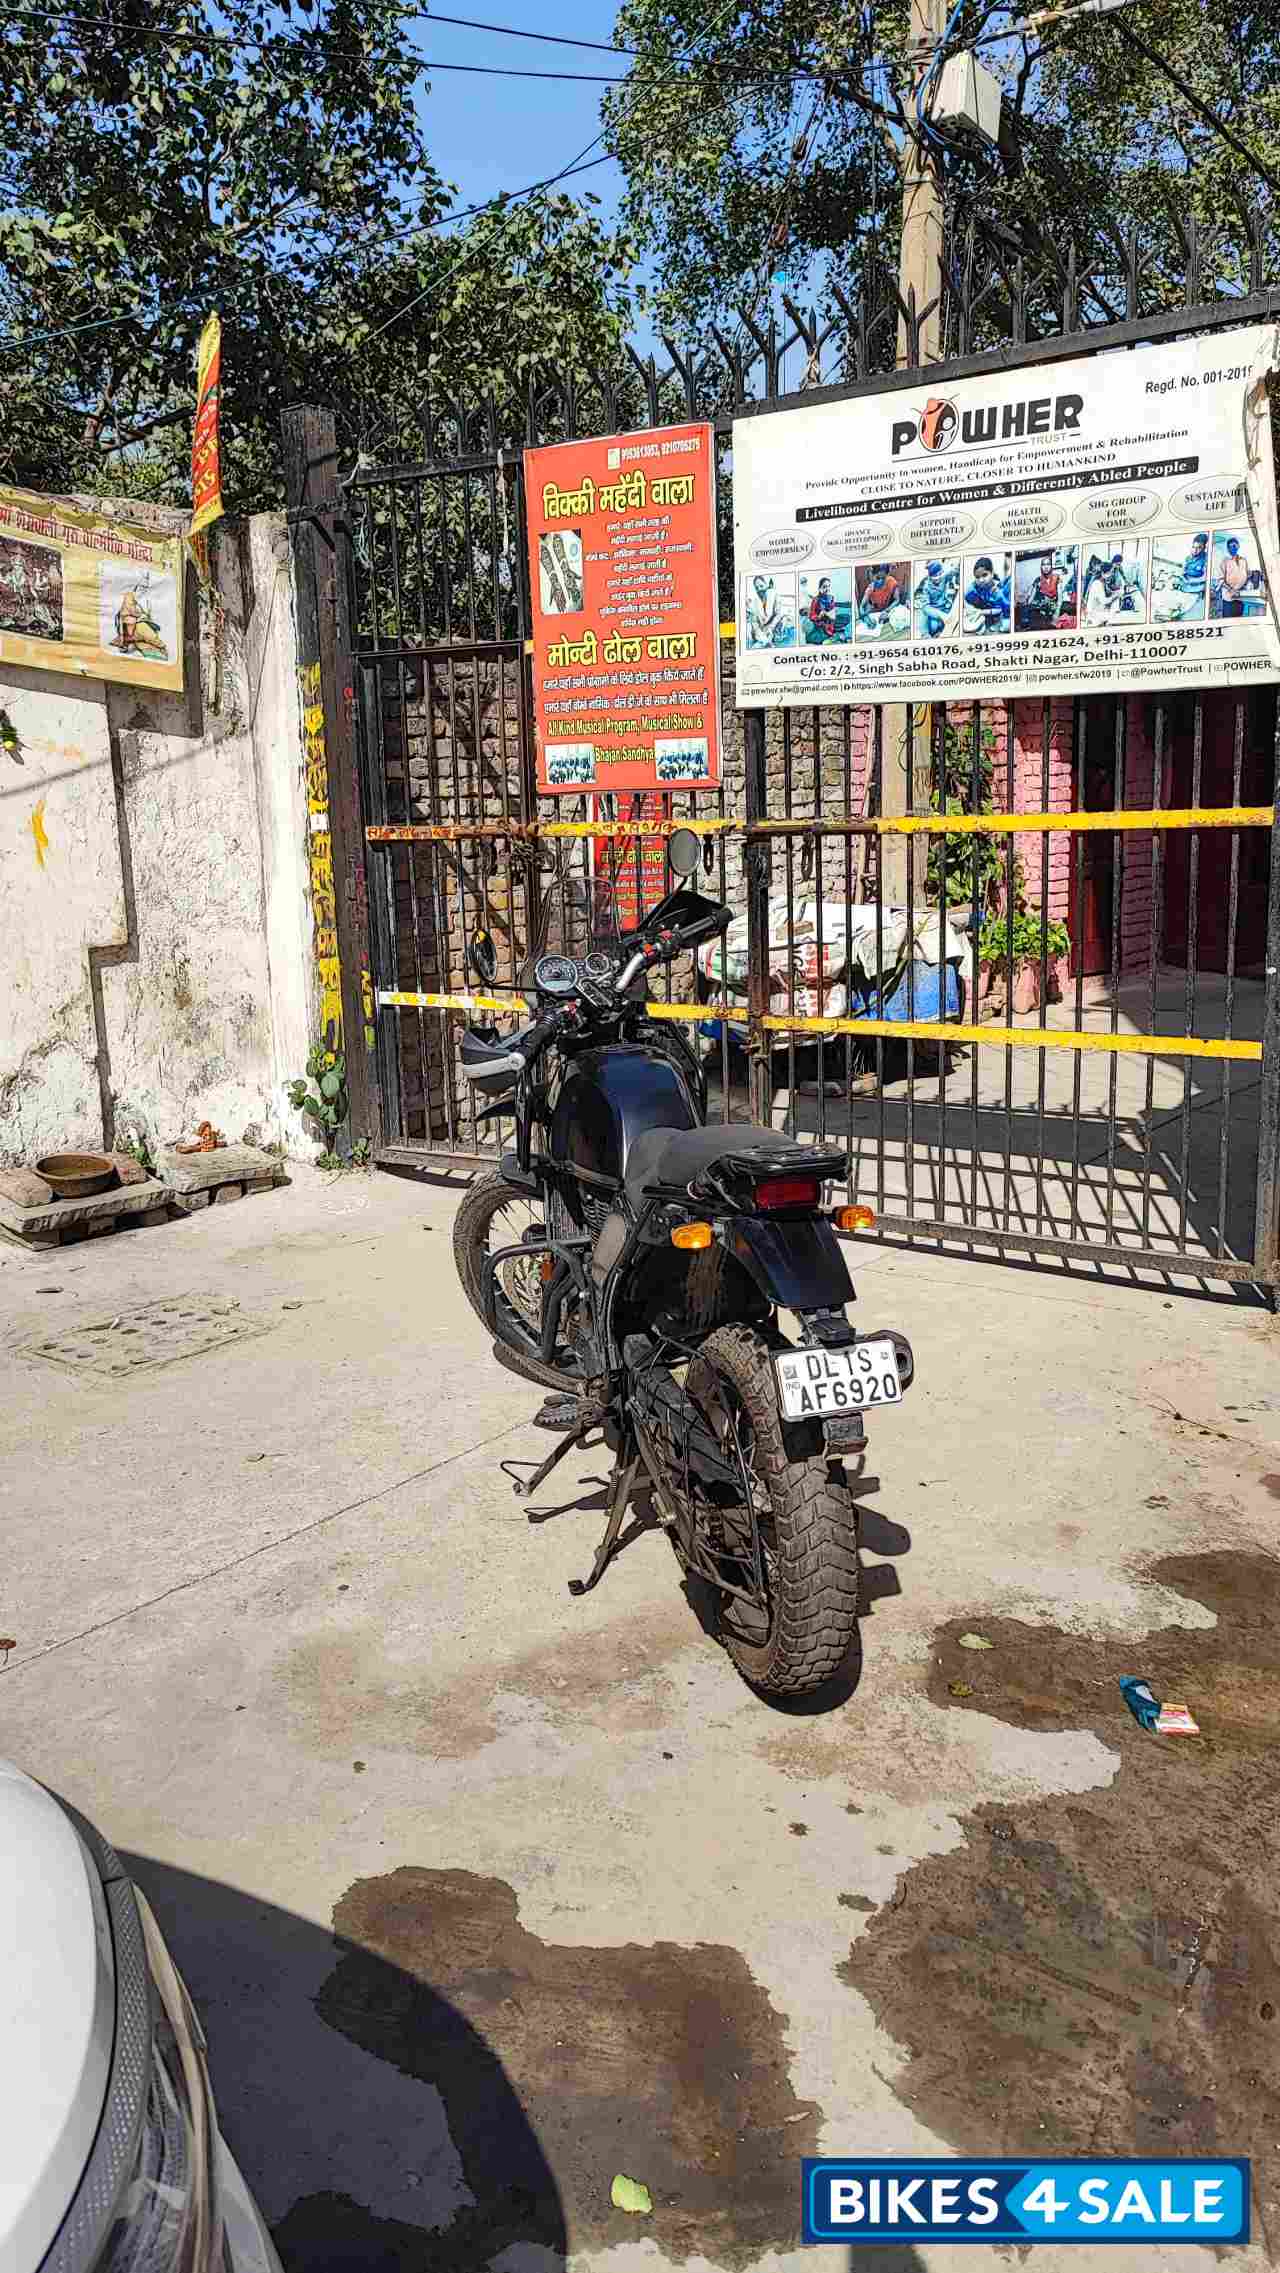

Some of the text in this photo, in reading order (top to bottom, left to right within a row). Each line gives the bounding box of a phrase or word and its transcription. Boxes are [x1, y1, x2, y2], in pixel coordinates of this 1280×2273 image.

[1181, 375, 1199, 388] No.
[1030, 432, 1067, 446] TRUST
[805, 478, 839, 490] Provide
[841, 470, 897, 486] Opportunity
[949, 456, 997, 470] Handicap
[999, 454, 1015, 464] for
[1017, 442, 1093, 460] Empowerment
[1095, 440, 1105, 449] &
[1110, 429, 1189, 447] Rehabilitation
[861, 482, 896, 496] CLOSE
[899, 480, 914, 490] TO
[967, 465, 1014, 482] CLOSER
[1017, 463, 1034, 474] TO
[1037, 453, 1117, 472] HUMANKIND
[542, 470, 696, 519] विक्की महेंदी वाला
[804, 461, 1188, 520] Livelihood Centre for Women & Differently Abled People
[1088, 495, 1147, 511] SHG GROUP
[1205, 500, 1226, 511] LIFE
[1008, 507, 1042, 517] HEALTH
[1105, 508, 1127, 519] FOR
[919, 517, 956, 528] SUPPORT
[1000, 516, 1049, 529] AWARENESS
[1096, 518, 1136, 530] WOMEN
[910, 526, 965, 538] DIFFERENTLY
[1002, 527, 1046, 538] PROGRAM
[768, 537, 795, 546] WOMEN
[925, 537, 951, 546] ABLED
[755, 544, 810, 558] EMPOWERMENT
[546, 631, 697, 667] मोन्टी ढोल वाला
[773, 654, 817, 665] Contact
[820, 653, 842, 662] No.
[853, 648, 909, 660] +91-9654
[912, 645, 963, 657] 610176,
[966, 640, 1030, 653] +91-9999
[1033, 636, 1089, 650] 421624,
[1094, 630, 1163, 645] +91-8700
[1166, 626, 1224, 641] 588521
[799, 644, 1188, 679] C/o: 2/2, Singh Sabha Road, Shakti Nagar, Delhi-110007
[1223, 660, 1273, 671] POWHER
[547, 719, 558, 736] All
[558, 718, 575, 736] Kind
[575, 717, 605, 735] Musical
[640, 713, 672, 732] Musical
[672, 712, 693, 730] Show
[800, 1372, 898, 1413] AF6920
